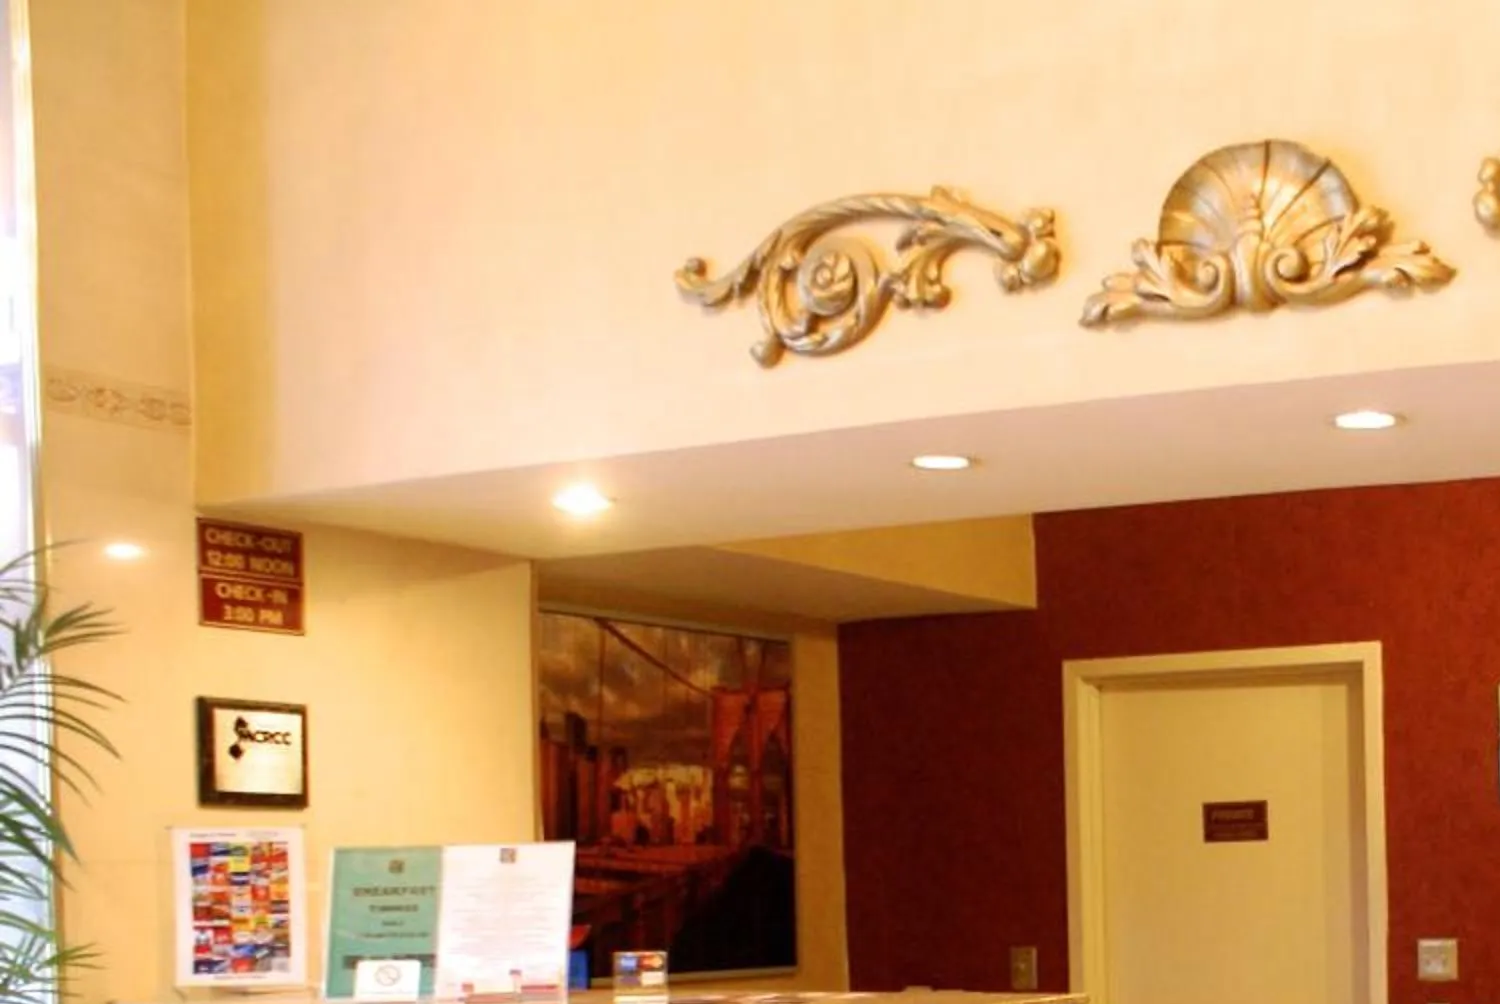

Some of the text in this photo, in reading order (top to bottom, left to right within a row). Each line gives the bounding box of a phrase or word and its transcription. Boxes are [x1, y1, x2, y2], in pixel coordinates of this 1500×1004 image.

[205, 527, 292, 553] CHECK-OUT
[249, 556, 294, 576] NOON
[259, 609, 284, 625] PM
